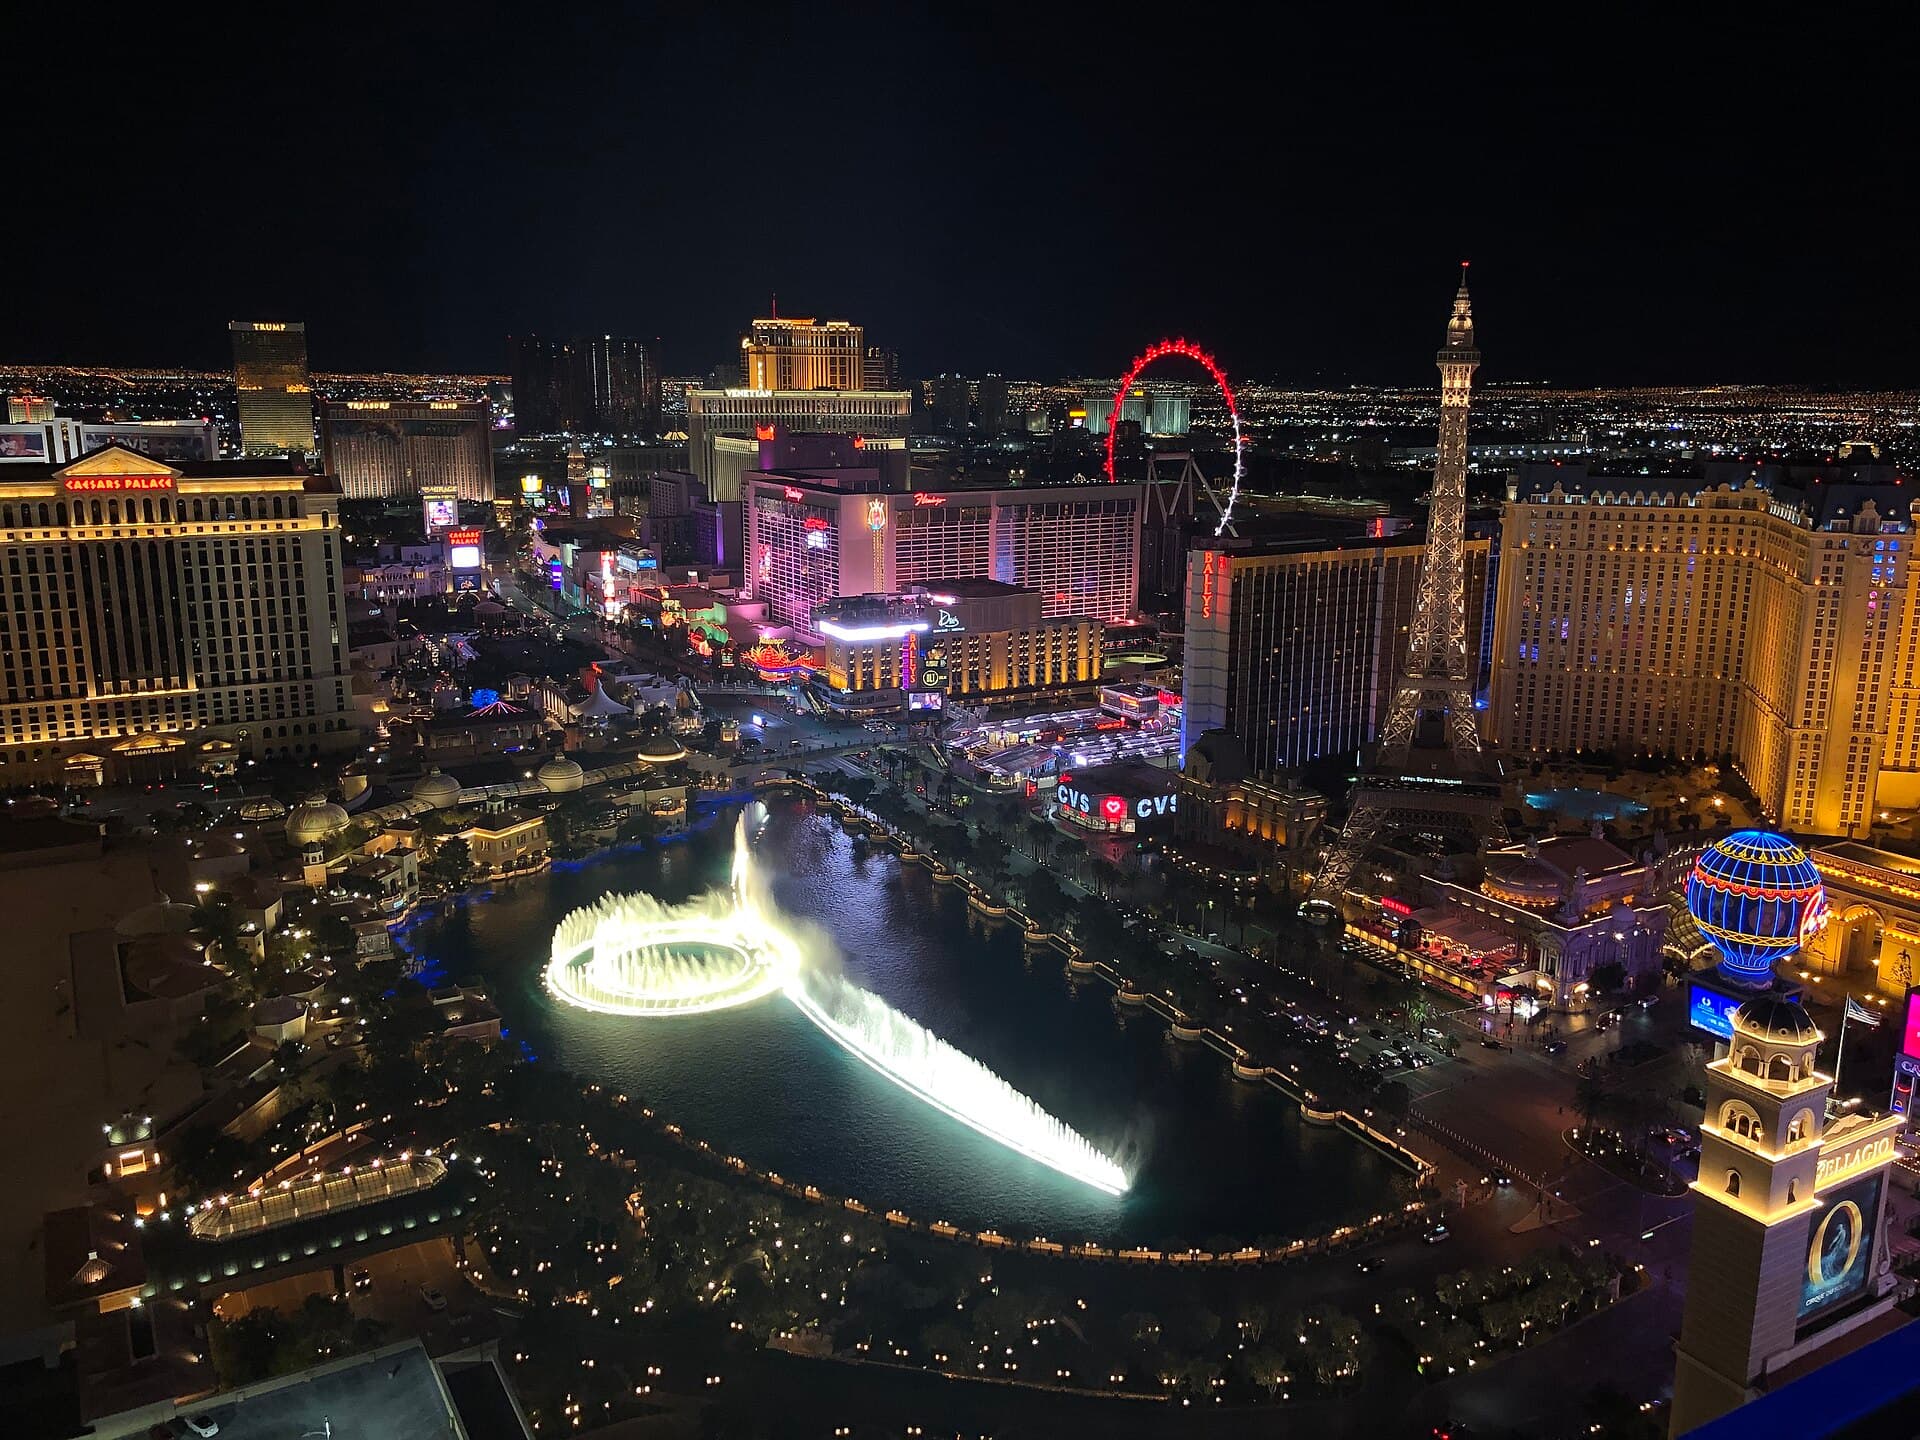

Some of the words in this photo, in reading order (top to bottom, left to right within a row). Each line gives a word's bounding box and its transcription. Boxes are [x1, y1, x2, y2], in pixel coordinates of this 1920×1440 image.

[253, 323, 286, 331] TRUMP
[725, 388, 773, 398] VENETIAN
[347, 402, 390, 410] TREASURE
[430, 402, 458, 410] ISLAND
[65, 479, 121, 490] CAESARS
[124, 479, 172, 489] PALACE
[449, 531, 480, 539] CAESARS
[1057, 784, 1090, 813] CVS
